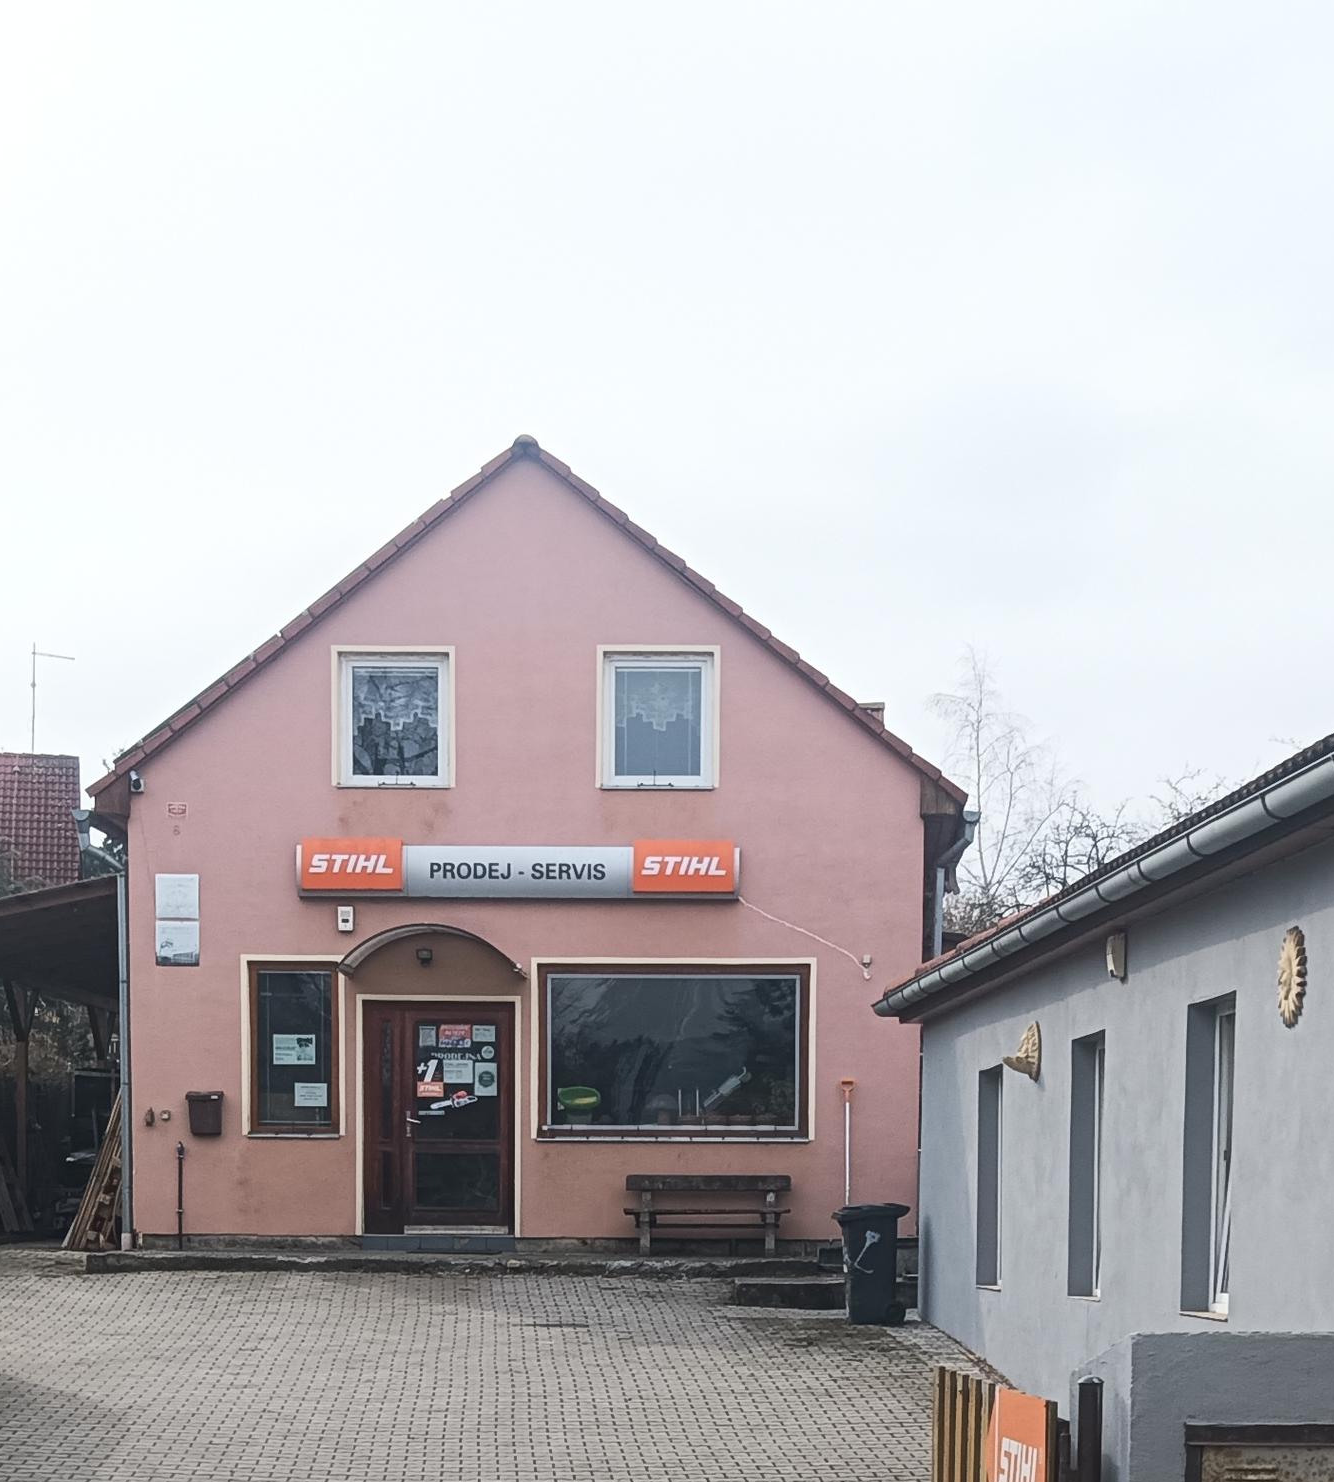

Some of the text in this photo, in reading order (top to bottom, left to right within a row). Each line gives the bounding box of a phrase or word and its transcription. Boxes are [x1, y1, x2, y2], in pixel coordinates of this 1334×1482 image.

[308, 854, 394, 875] STIHL
[429, 862, 512, 881] PRODEJ
[530, 862, 606, 881] SERVIS
[641, 855, 727, 876] STIHL
